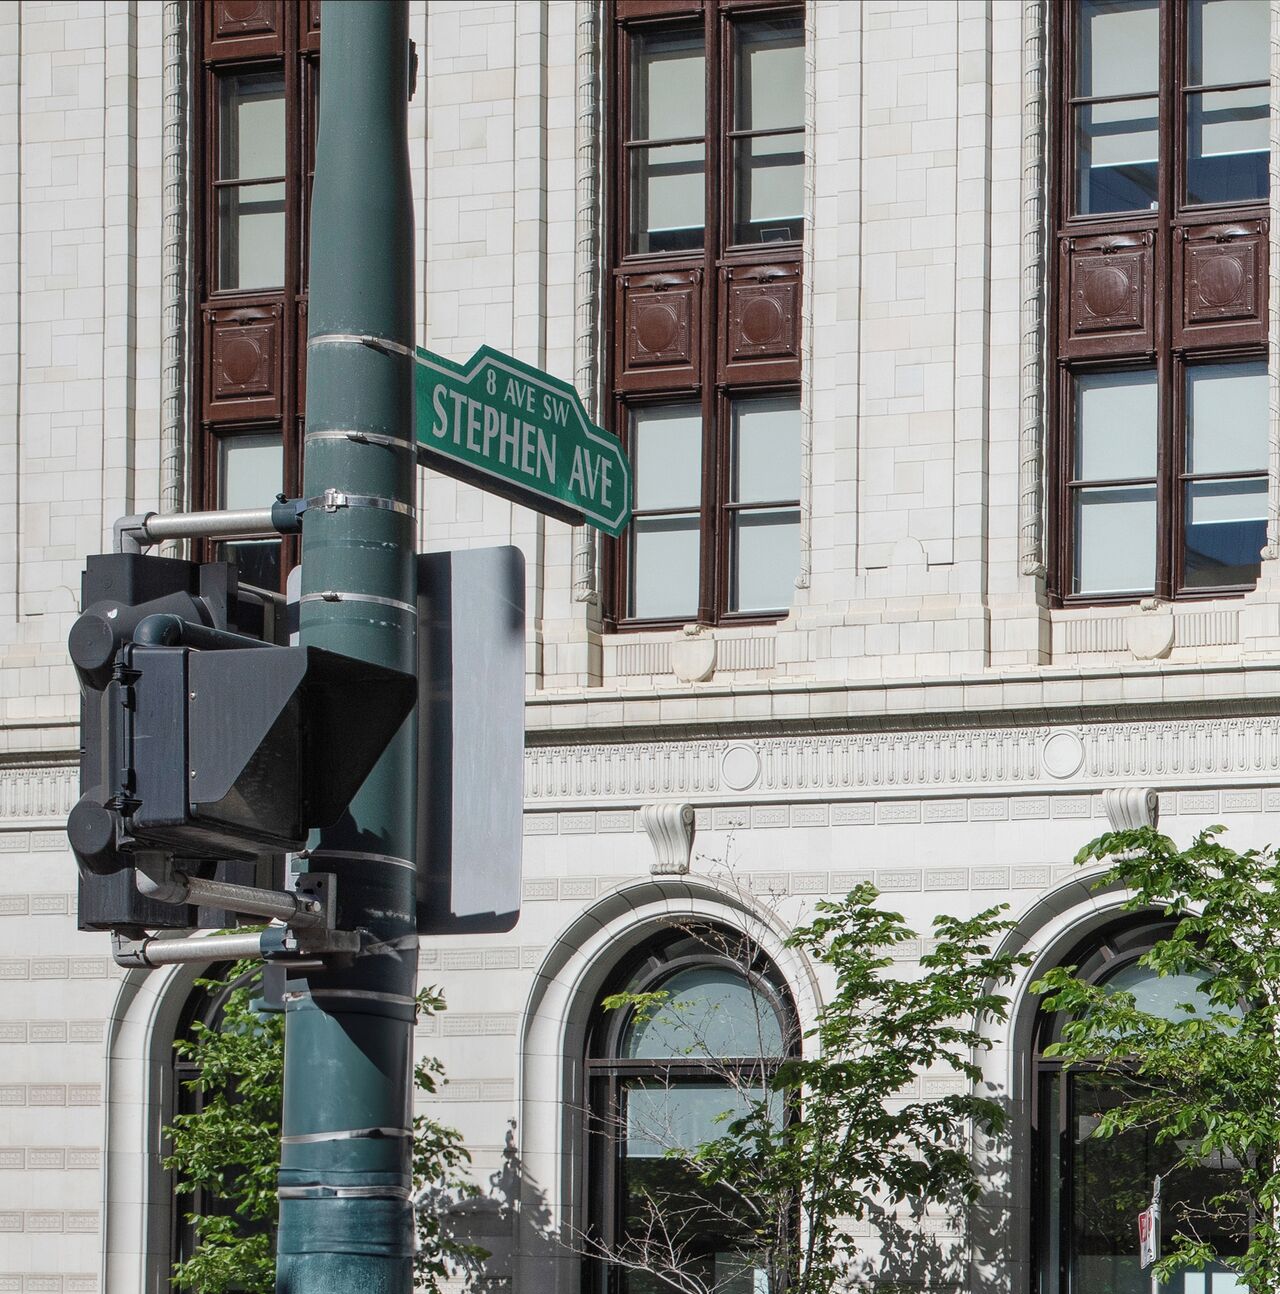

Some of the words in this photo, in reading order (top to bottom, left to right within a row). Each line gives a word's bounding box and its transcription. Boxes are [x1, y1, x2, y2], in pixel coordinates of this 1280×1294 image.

[486, 368, 497, 396] 8
[504, 378, 536, 413] AVE
[543, 393, 570, 427] SW
[432, 383, 557, 485] STEPHEN
[568, 445, 613, 509] AVE
